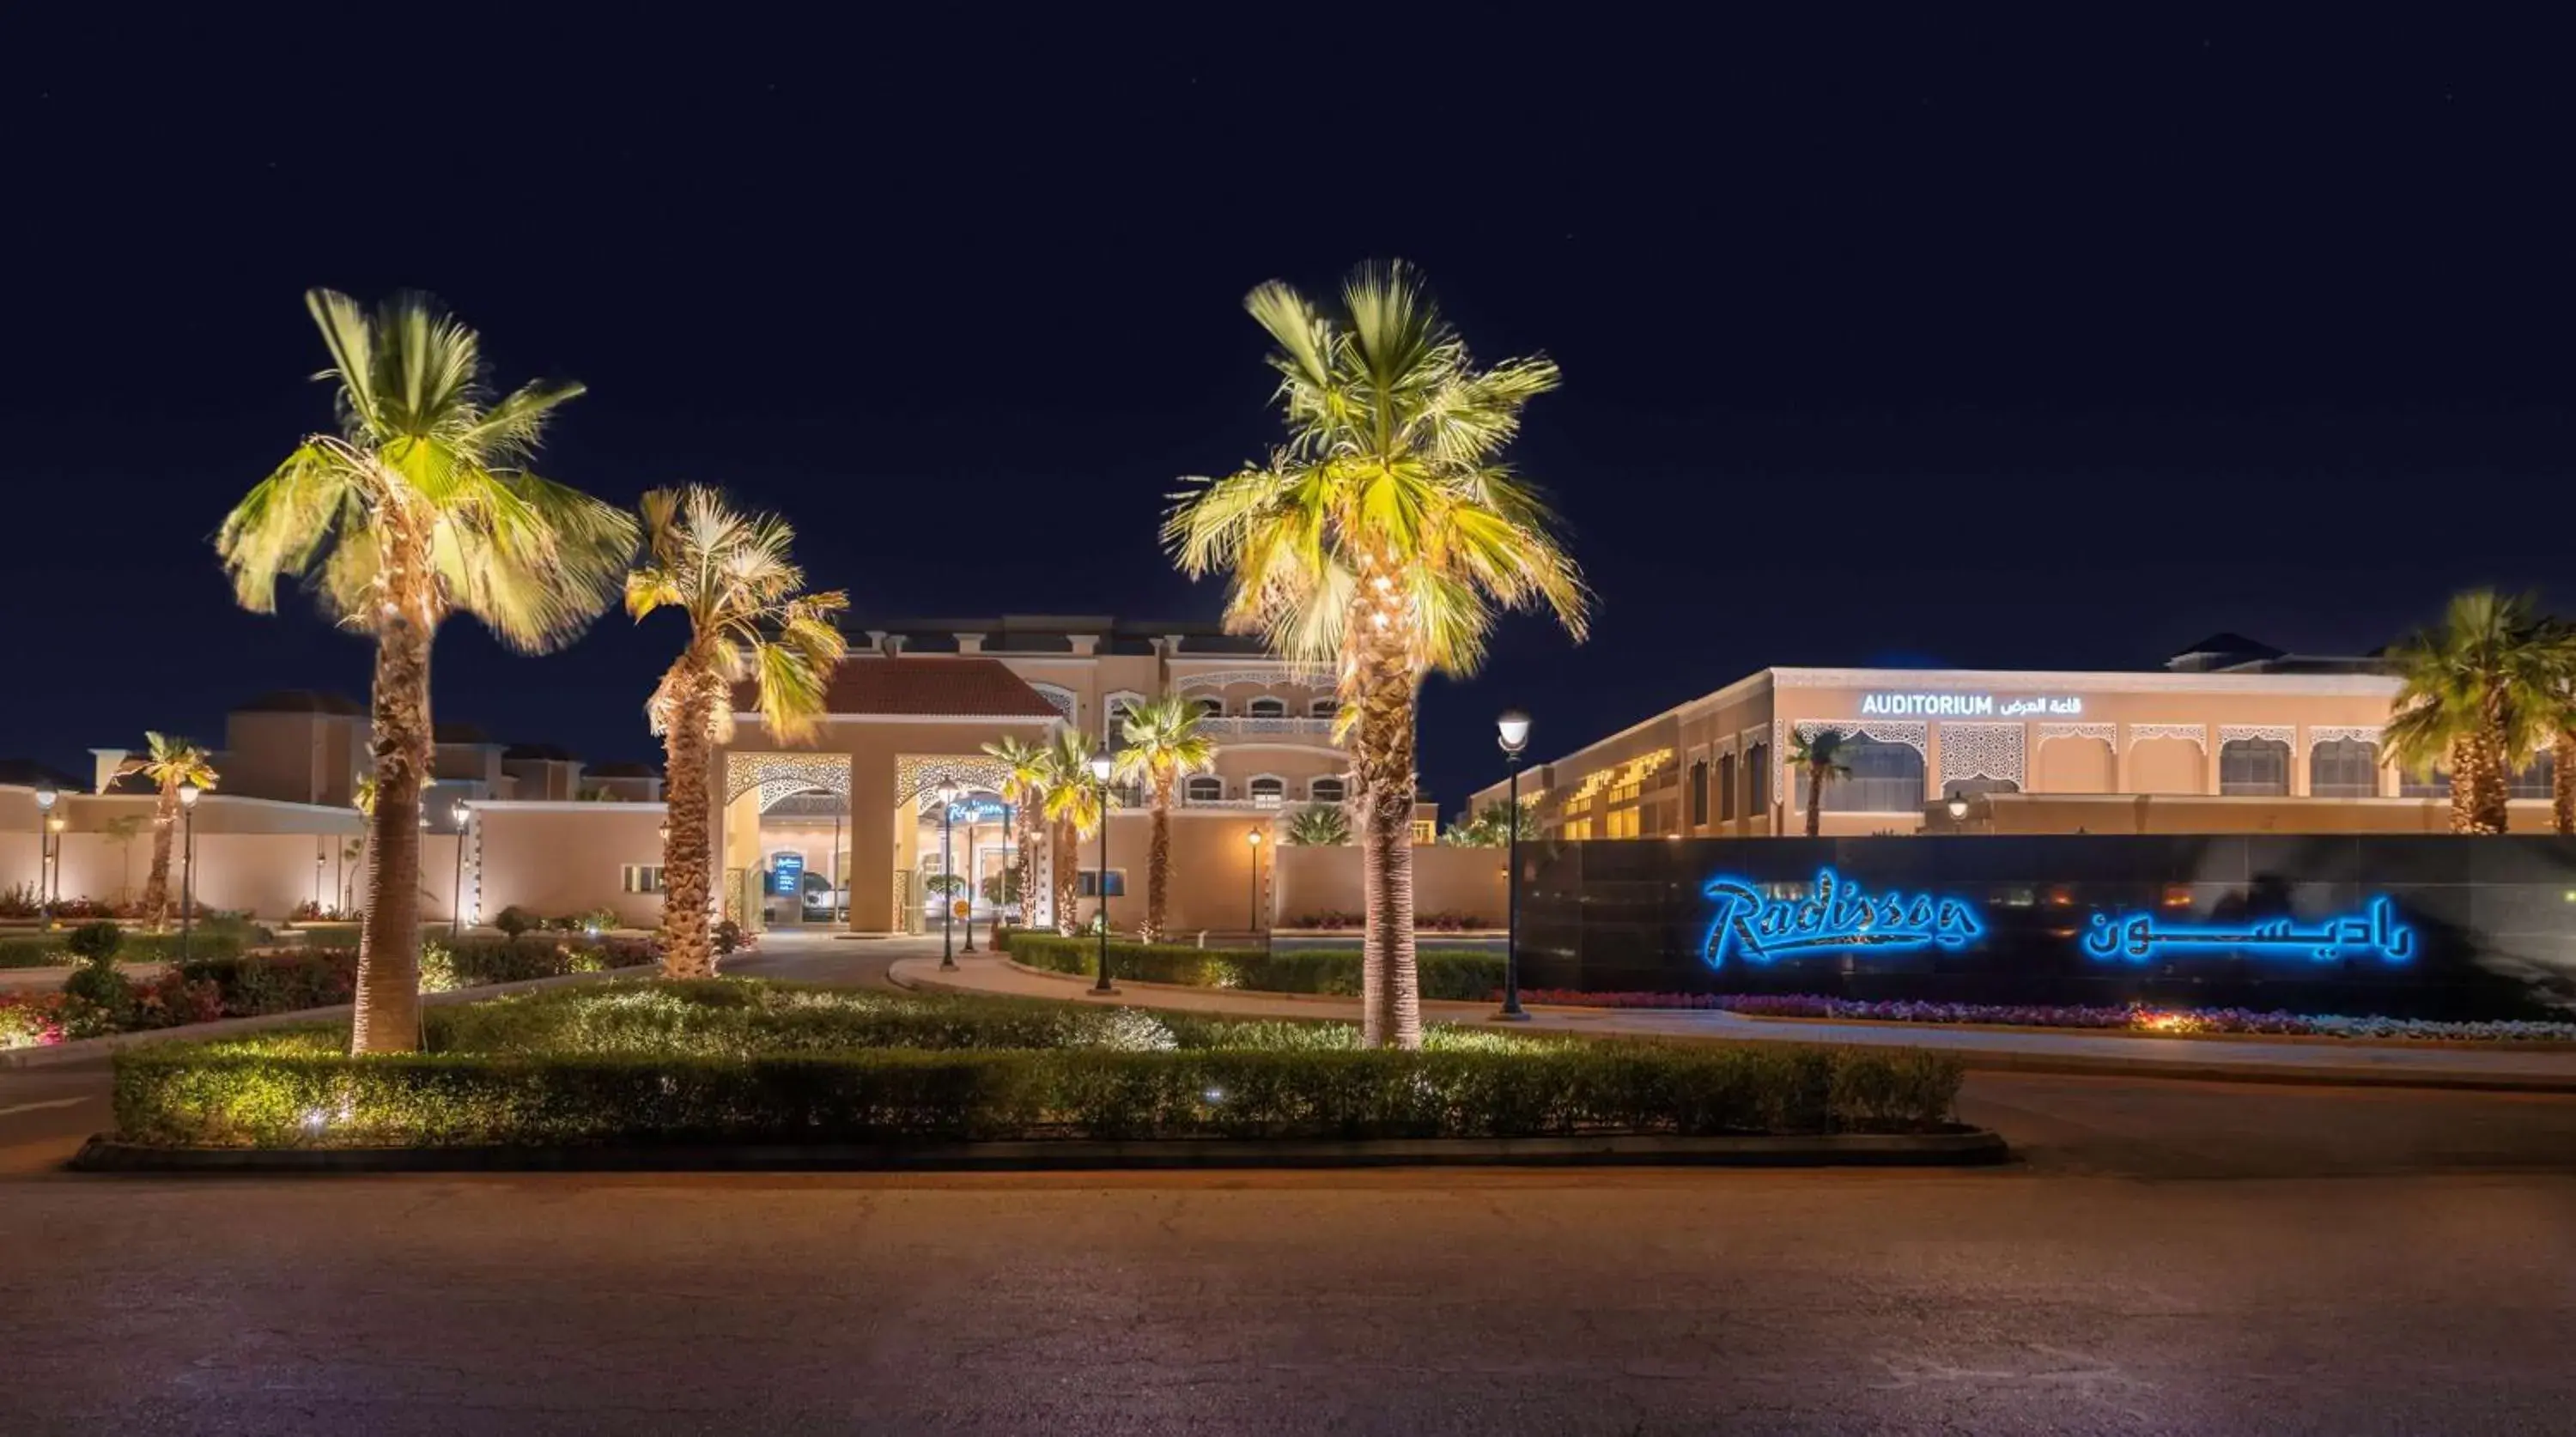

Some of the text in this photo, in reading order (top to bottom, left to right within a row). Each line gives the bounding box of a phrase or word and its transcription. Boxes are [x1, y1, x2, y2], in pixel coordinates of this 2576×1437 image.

[1863, 694, 1992, 714] AUDITORIUM
[2000, 697, 2082, 716] قاعة العرض
[1704, 867, 1979, 967] Radisson
[2086, 895, 2414, 961] راديسون
